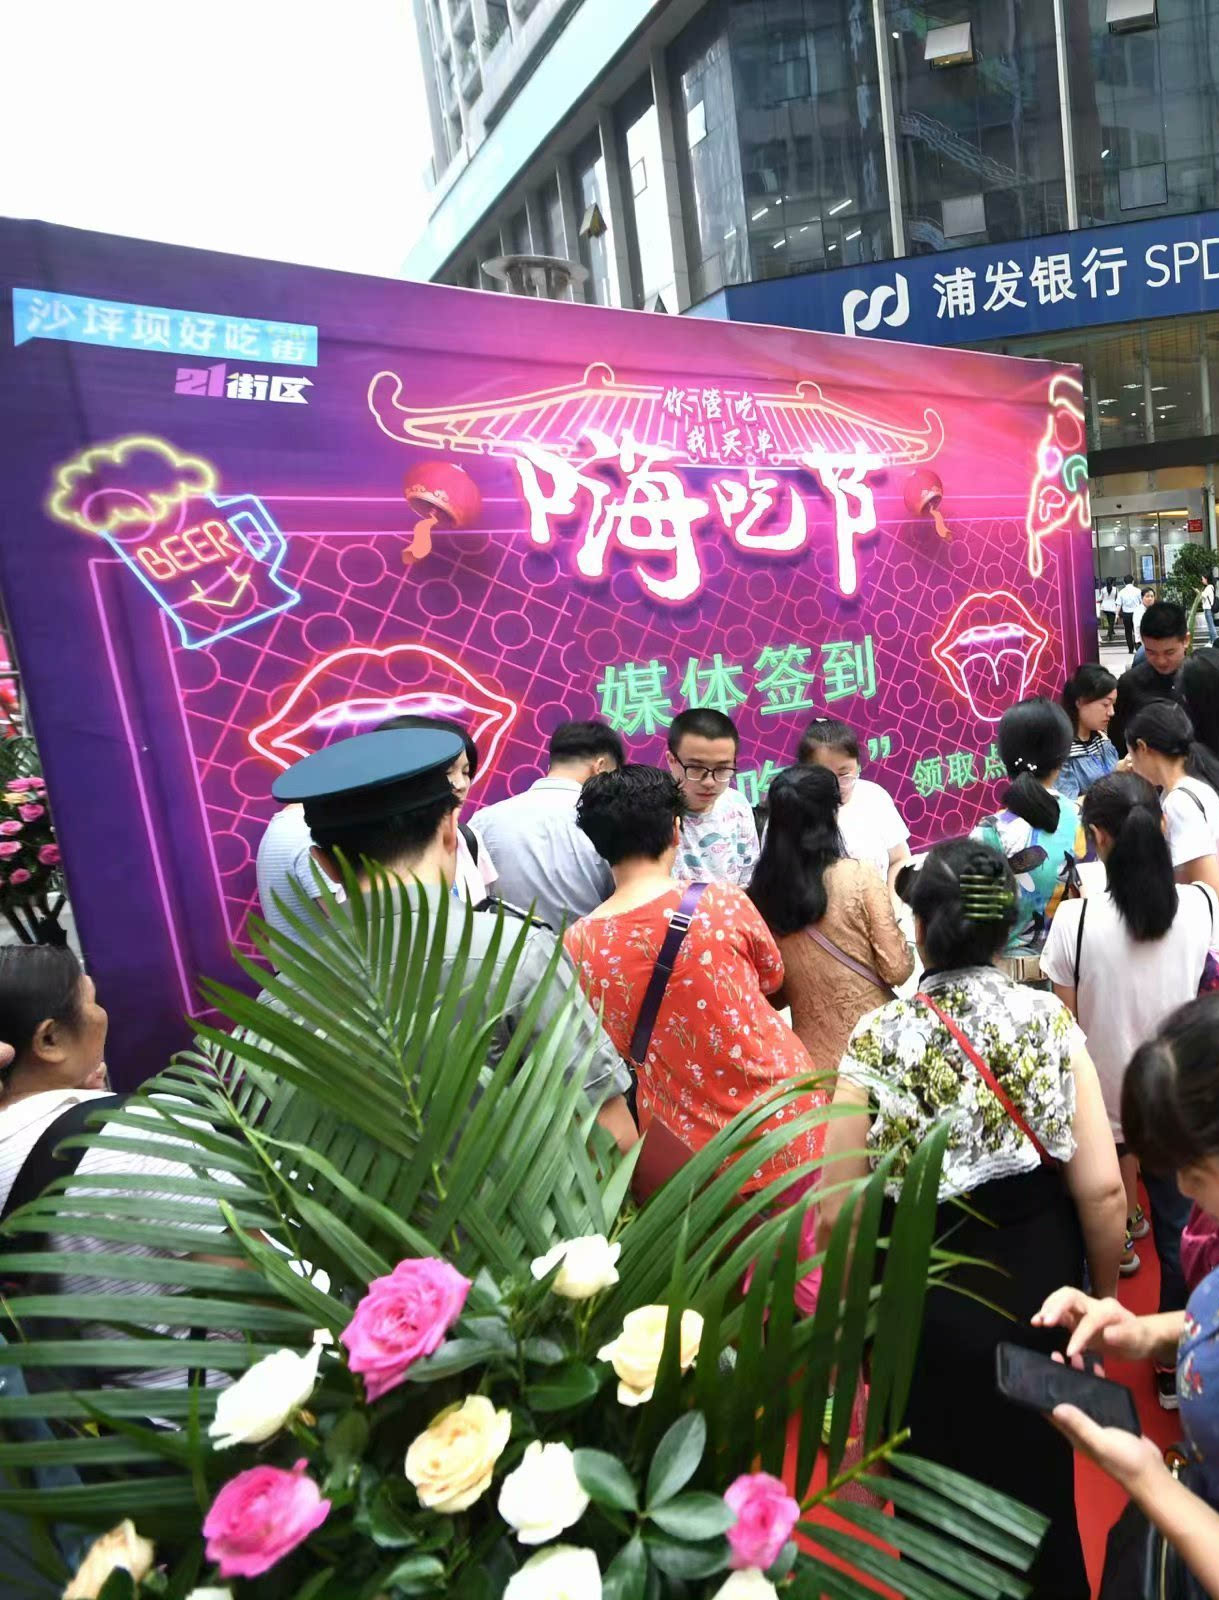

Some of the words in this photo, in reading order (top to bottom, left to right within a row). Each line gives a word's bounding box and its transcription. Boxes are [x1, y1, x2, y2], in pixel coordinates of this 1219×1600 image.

[933, 247, 1127, 319] 浦发银行
[26, 297, 309, 363] 沙坪坝好吃街
[174, 363, 315, 405] 21街区
[662, 386, 758, 422] 你管吃
[687, 425, 774, 459] 我买单
[515, 428, 890, 602] 嗨吃节
[136, 519, 242, 581] BEER
[597, 634, 878, 738] 媒体签到
